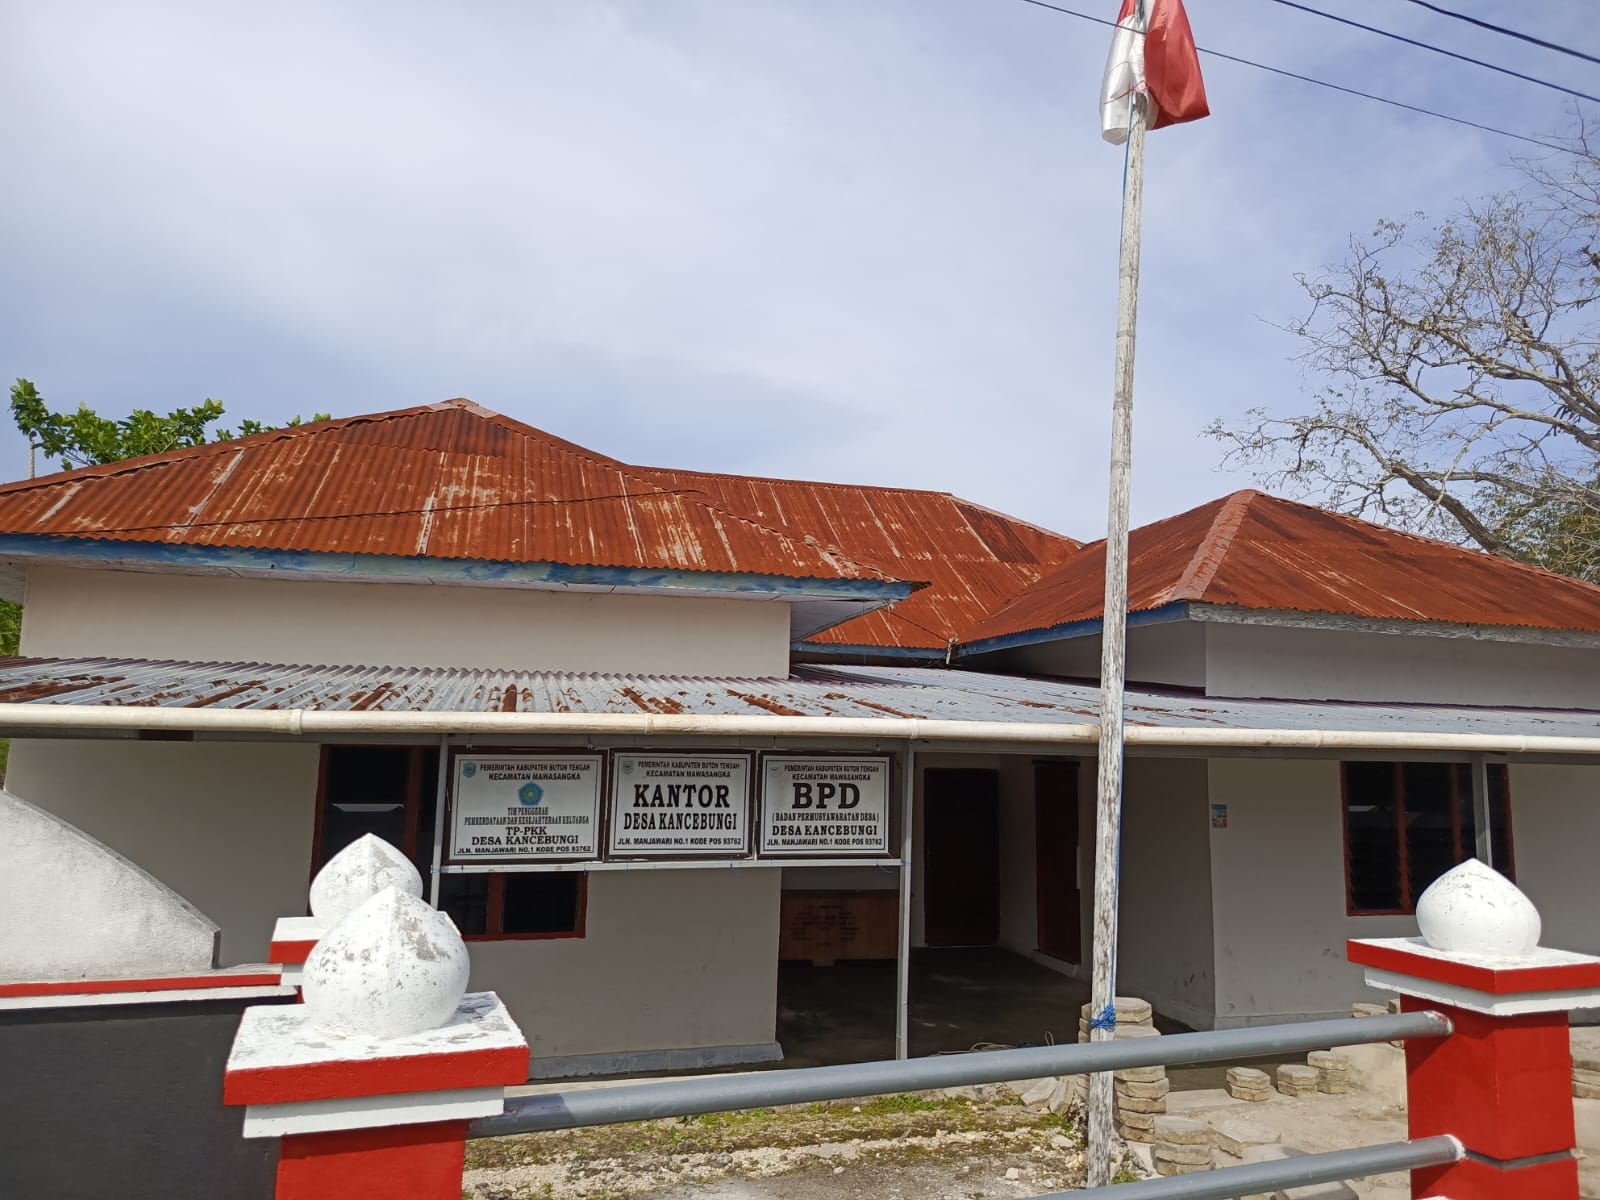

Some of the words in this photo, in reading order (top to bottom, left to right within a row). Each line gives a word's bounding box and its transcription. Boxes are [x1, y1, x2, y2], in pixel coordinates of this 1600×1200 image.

[633, 784, 730, 808] KANTOR
[792, 783, 860, 809] BPD
[518, 807, 549, 815] PENGGERAK
[562, 816, 589, 824] KELUARGA
[624, 813, 656, 830] DESA
[659, 813, 737, 830] KANCEBUNGI
[798, 813, 860, 821] PERMUSYAWARATAN
[506, 826, 547, 835] TP-PKK
[772, 826, 802, 836] DESA
[805, 826, 877, 835] KANCEBUNGI
[472, 836, 501, 845] DESA
[506, 835, 579, 844] KANCEBUNGI
